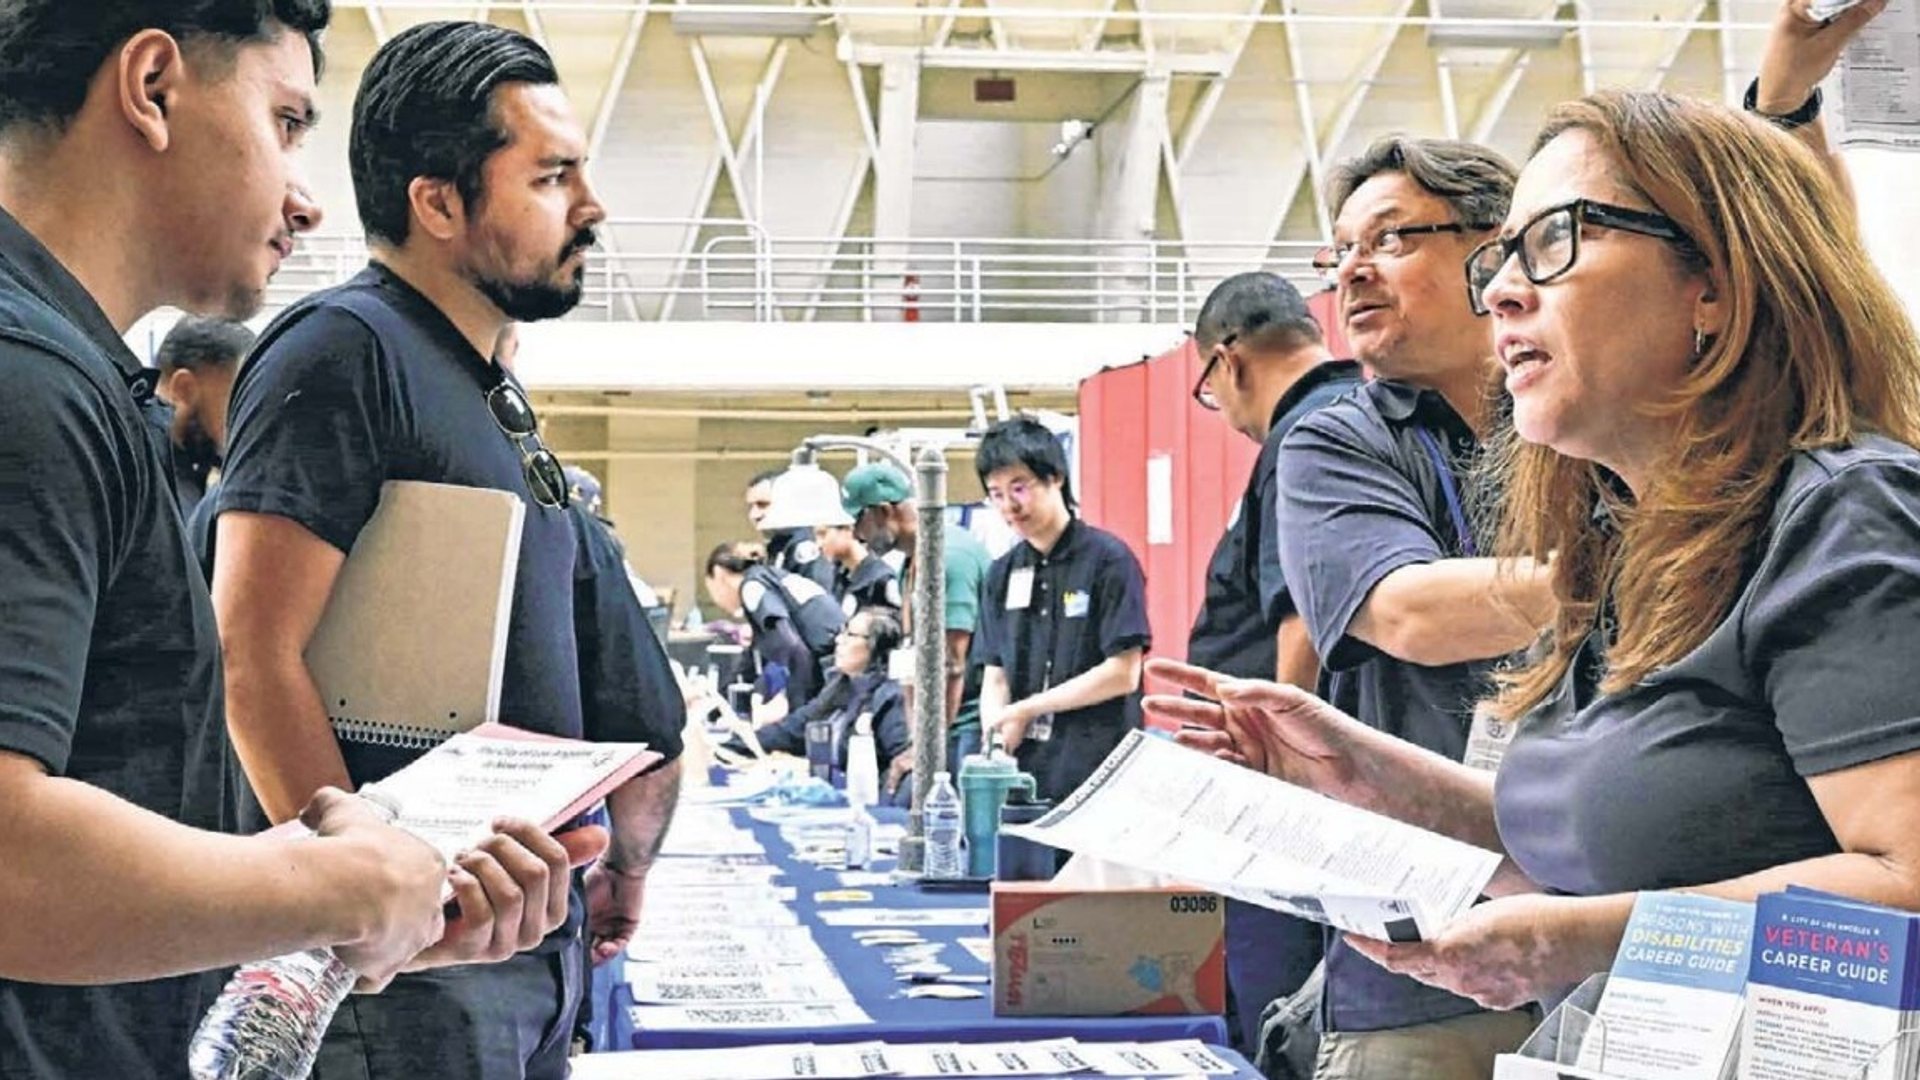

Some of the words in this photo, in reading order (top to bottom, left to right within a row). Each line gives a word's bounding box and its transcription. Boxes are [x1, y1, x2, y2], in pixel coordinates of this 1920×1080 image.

[1637, 911, 1704, 933] PERSONS
[1711, 921, 1750, 938] WITH
[1631, 927, 1745, 957] DISABILITIES
[1765, 925, 1891, 964] VETERAN'S
[1625, 946, 1684, 966] CAREER
[1687, 953, 1738, 974] GUIDE
[1761, 949, 1832, 974] CAREER
[1836, 962, 1890, 985] GUIDE
